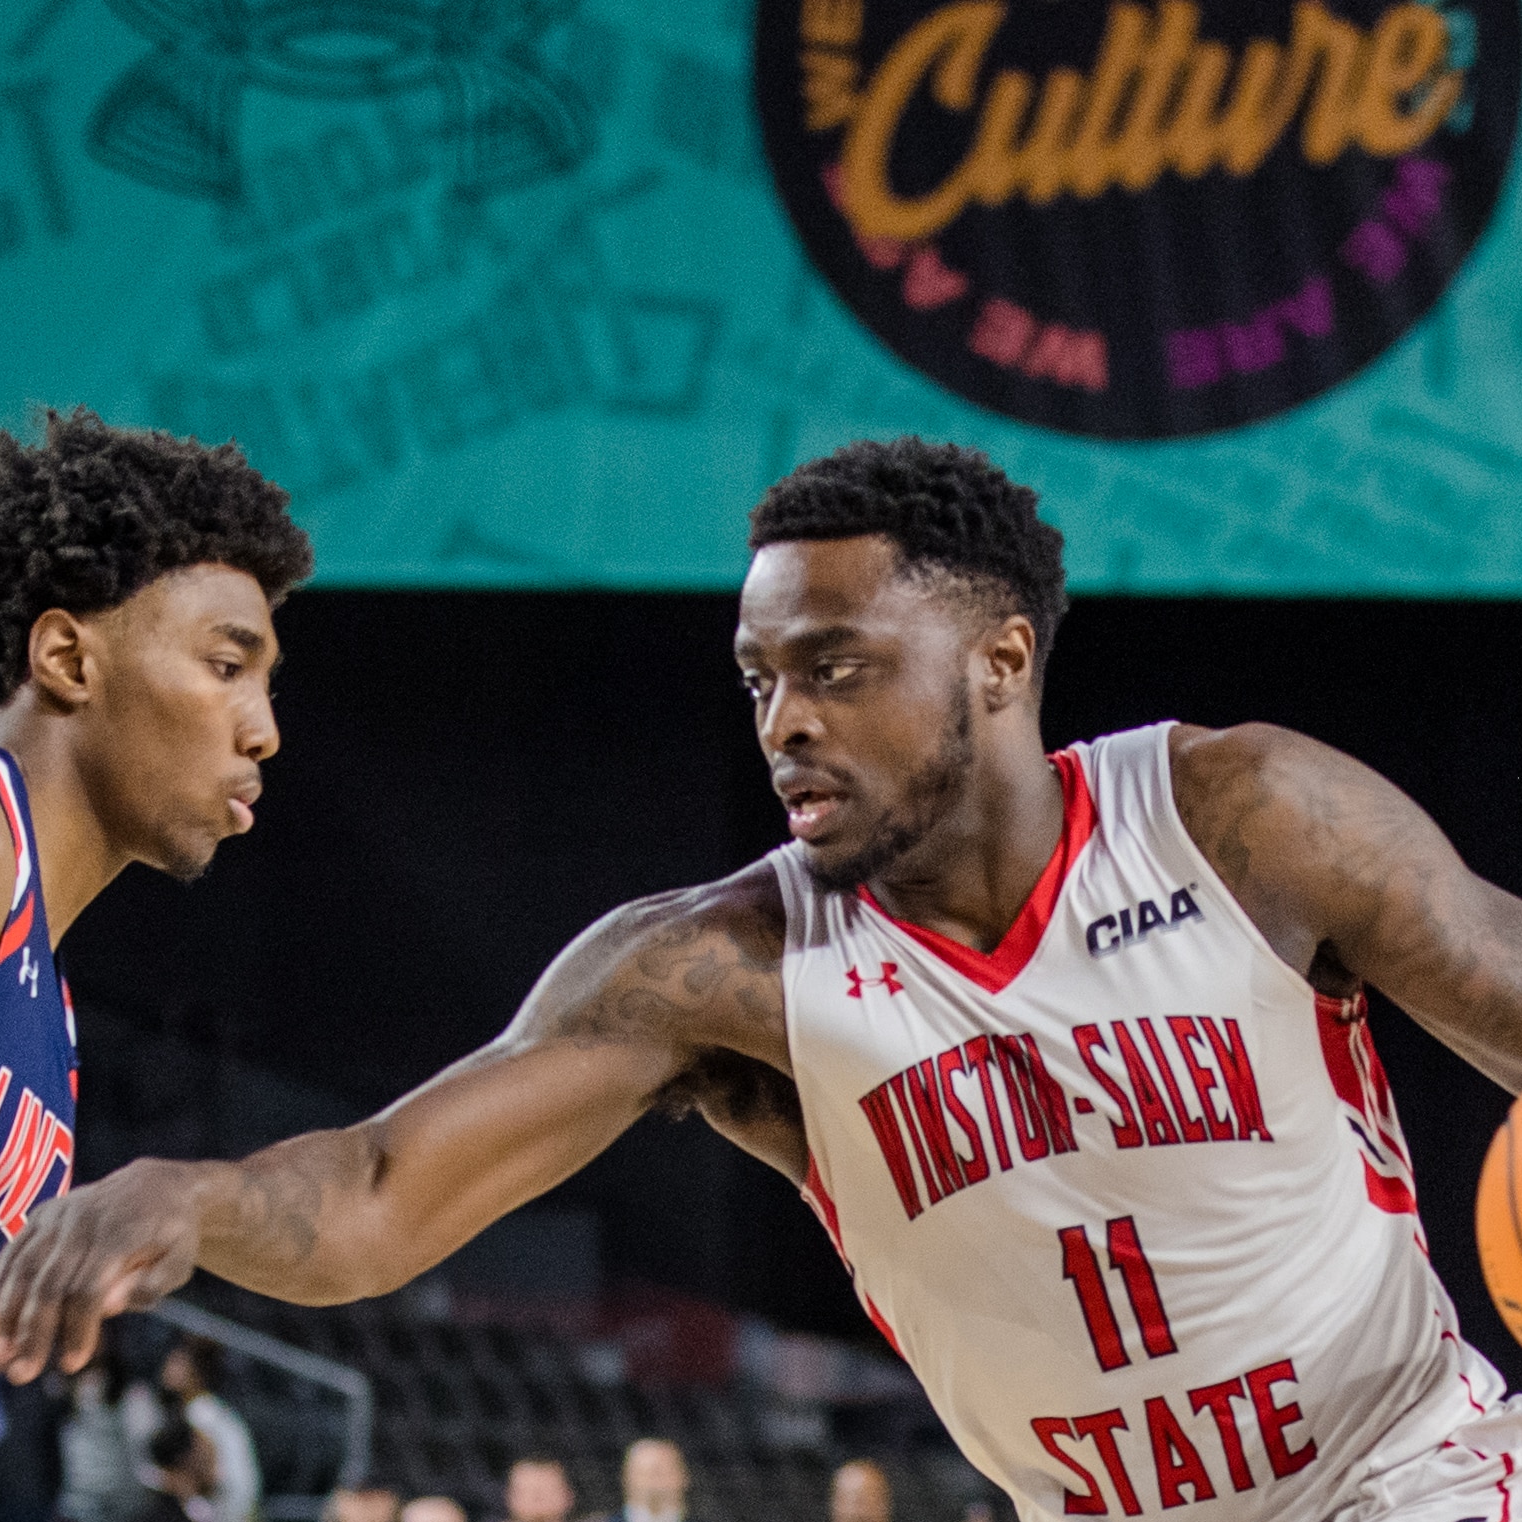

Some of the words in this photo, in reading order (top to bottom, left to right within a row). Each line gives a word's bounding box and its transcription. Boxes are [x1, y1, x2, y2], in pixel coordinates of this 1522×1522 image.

[837, 0, 1464, 240] Culture
[1085, 888, 1205, 959] CIAA
[858, 1015, 1274, 1221] WINSTON-SALEM
[1057, 1216, 1179, 1372] 11
[1030, 1358, 1317, 1516] STATE
